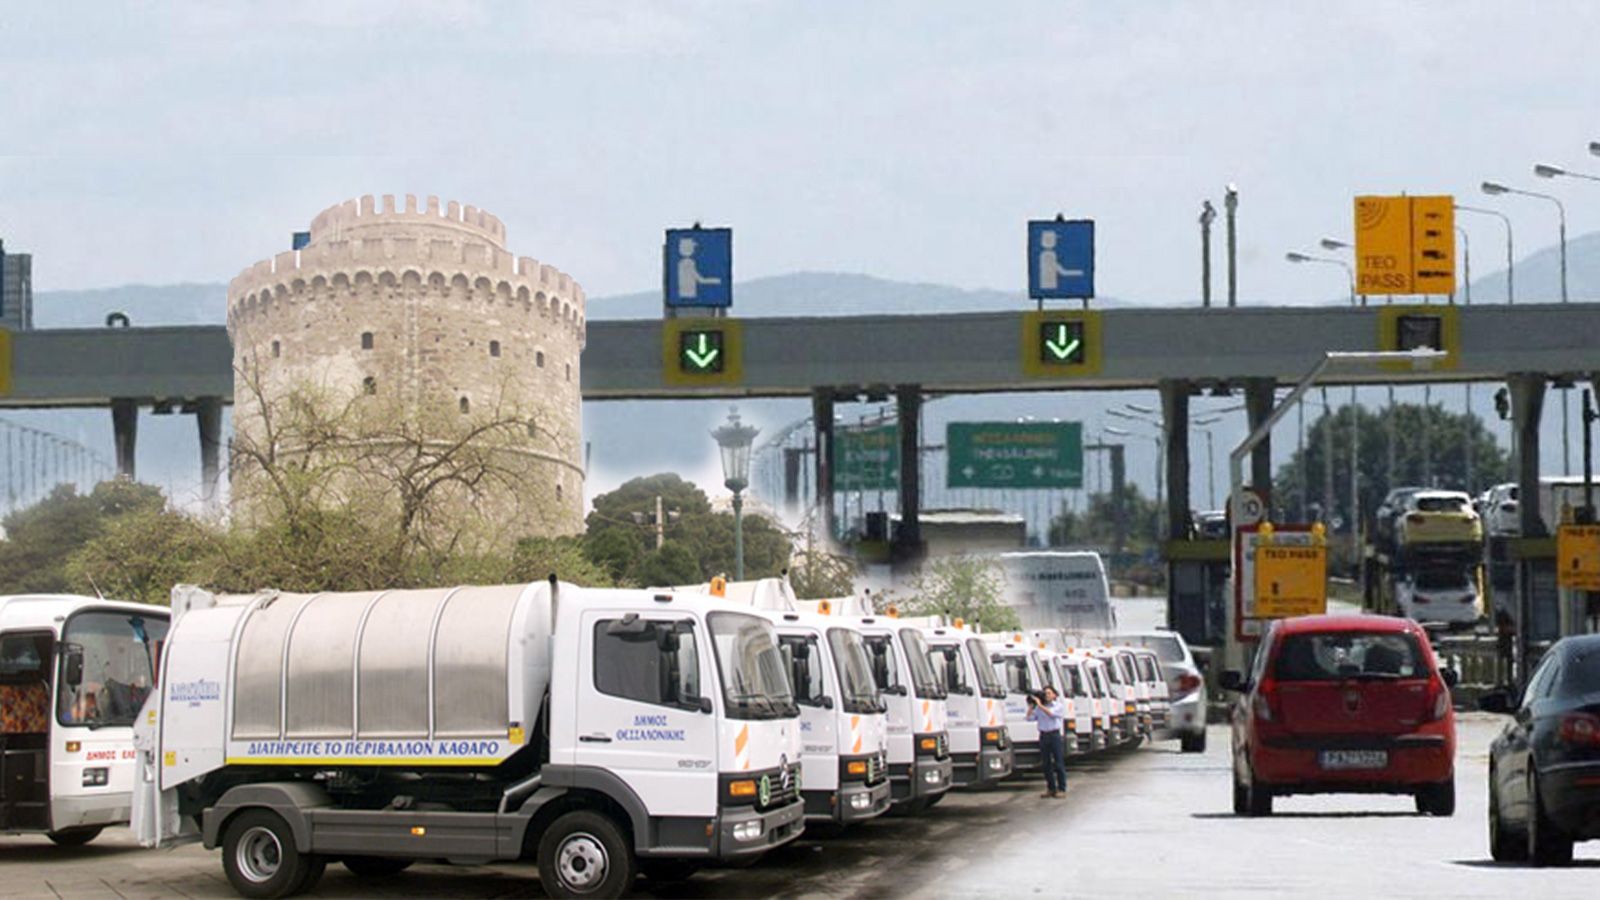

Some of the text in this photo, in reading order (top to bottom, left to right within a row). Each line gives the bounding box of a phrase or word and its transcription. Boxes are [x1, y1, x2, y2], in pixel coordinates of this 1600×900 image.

[1361, 272, 1406, 289] PASS
[633, 715, 668, 726] ΔΗΜΟΣ
[616, 729, 685, 741] ΘΕΣΣΑΛΟΝΙΚΗΣ
[247, 741, 499, 755] ΔΙΑΤΗΡΕΙΤΕ ΤΟ ΠΕΡΙΒΑΛΛΟΝ ΚΑΘΑΡΟ
[86, 751, 116, 761] ΔΗΜΟΣ
